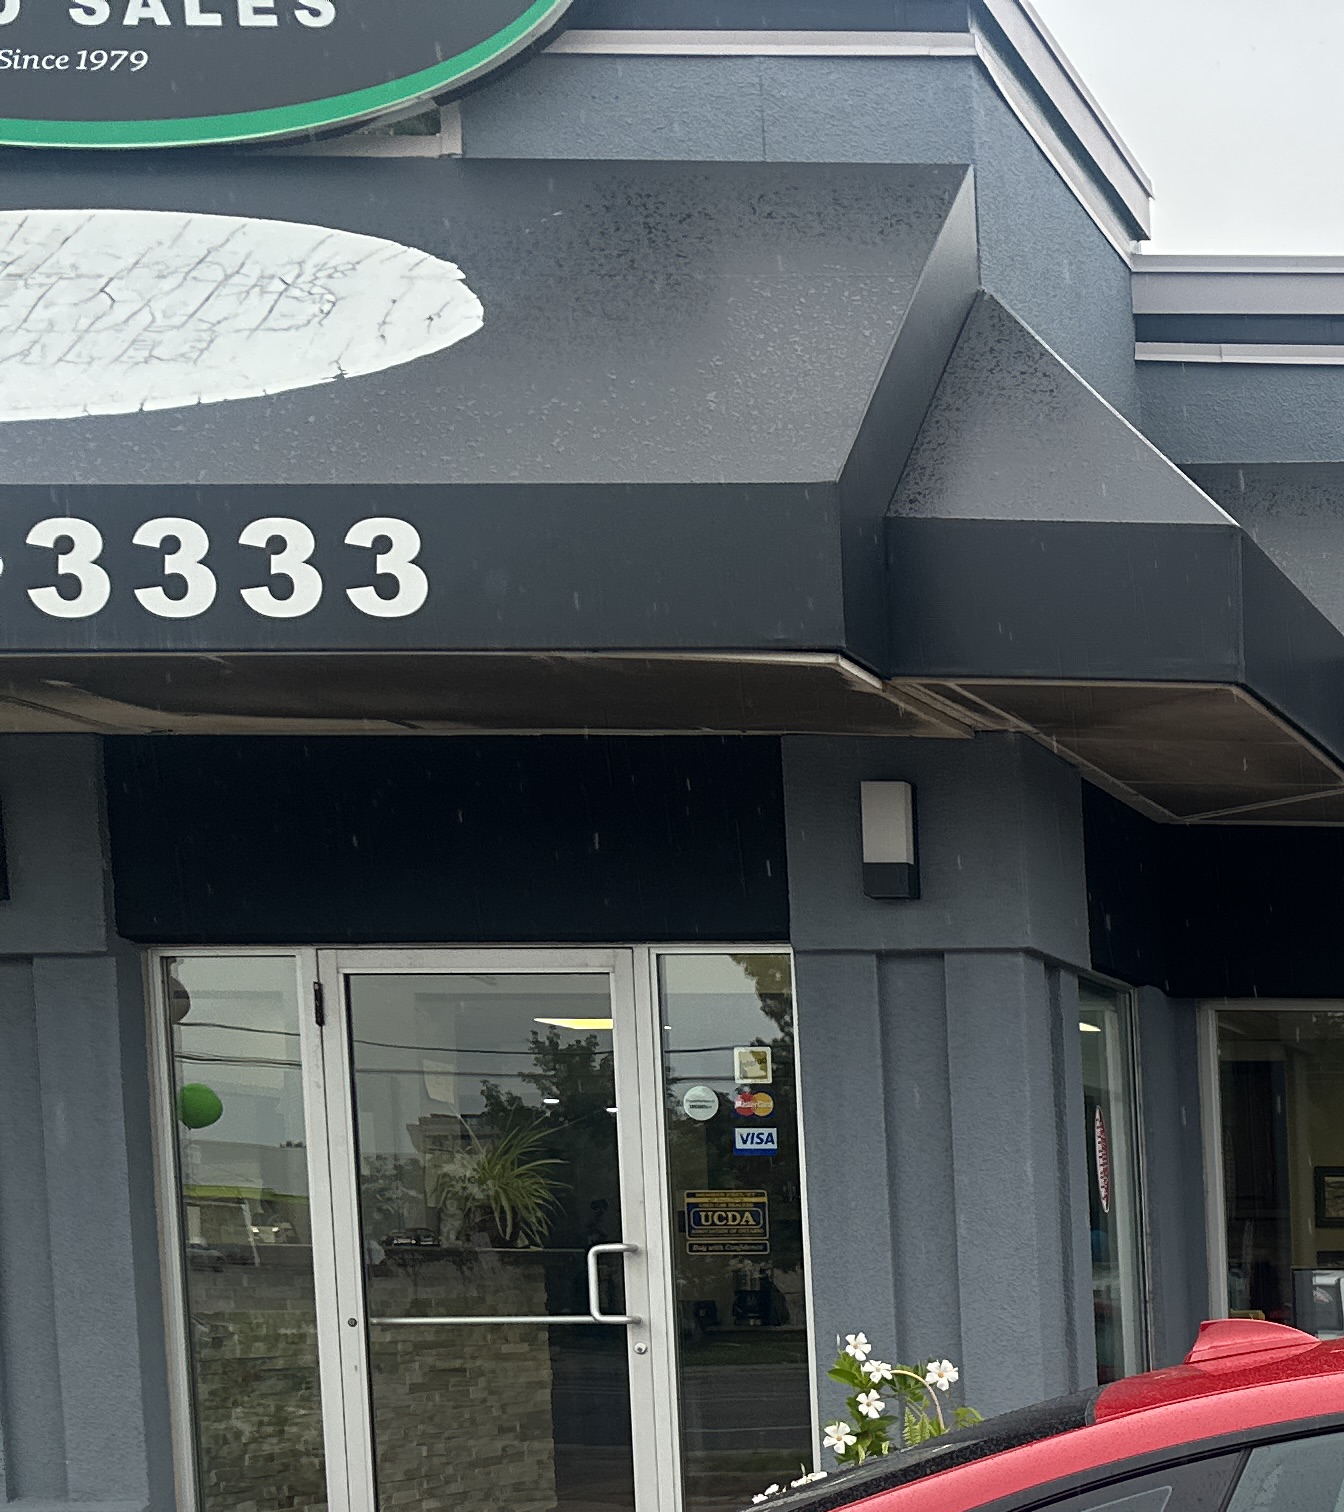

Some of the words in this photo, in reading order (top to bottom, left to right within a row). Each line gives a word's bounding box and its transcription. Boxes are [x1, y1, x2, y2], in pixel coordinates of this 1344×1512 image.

[68, 0, 336, 27] SALES
[0, 49, 69, 71] Since
[76, 49, 149, 72] 1979
[0, 517, 429, 618] 3333
[740, 1132, 775, 1144] VISA
[699, 1212, 756, 1225] UCDA
